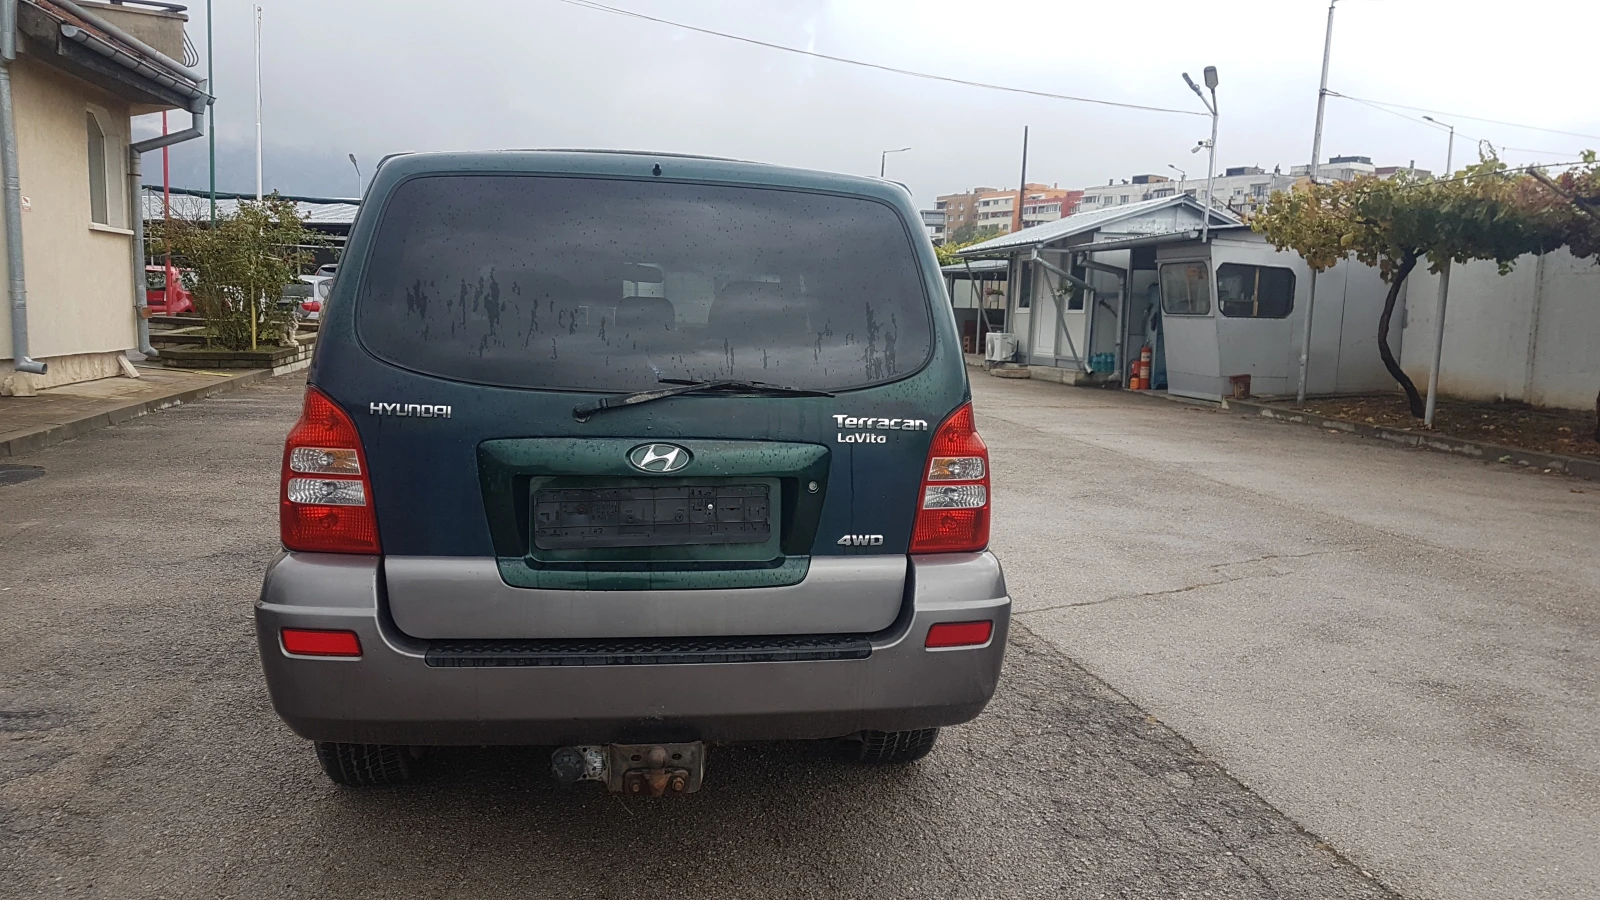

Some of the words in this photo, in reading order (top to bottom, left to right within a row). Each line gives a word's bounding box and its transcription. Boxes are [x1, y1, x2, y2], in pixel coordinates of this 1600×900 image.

[370, 402, 452, 418] HYUNDAI
[832, 414, 928, 431] Terracan
[837, 432, 887, 443] LaVita
[837, 534, 884, 546] 4WD
